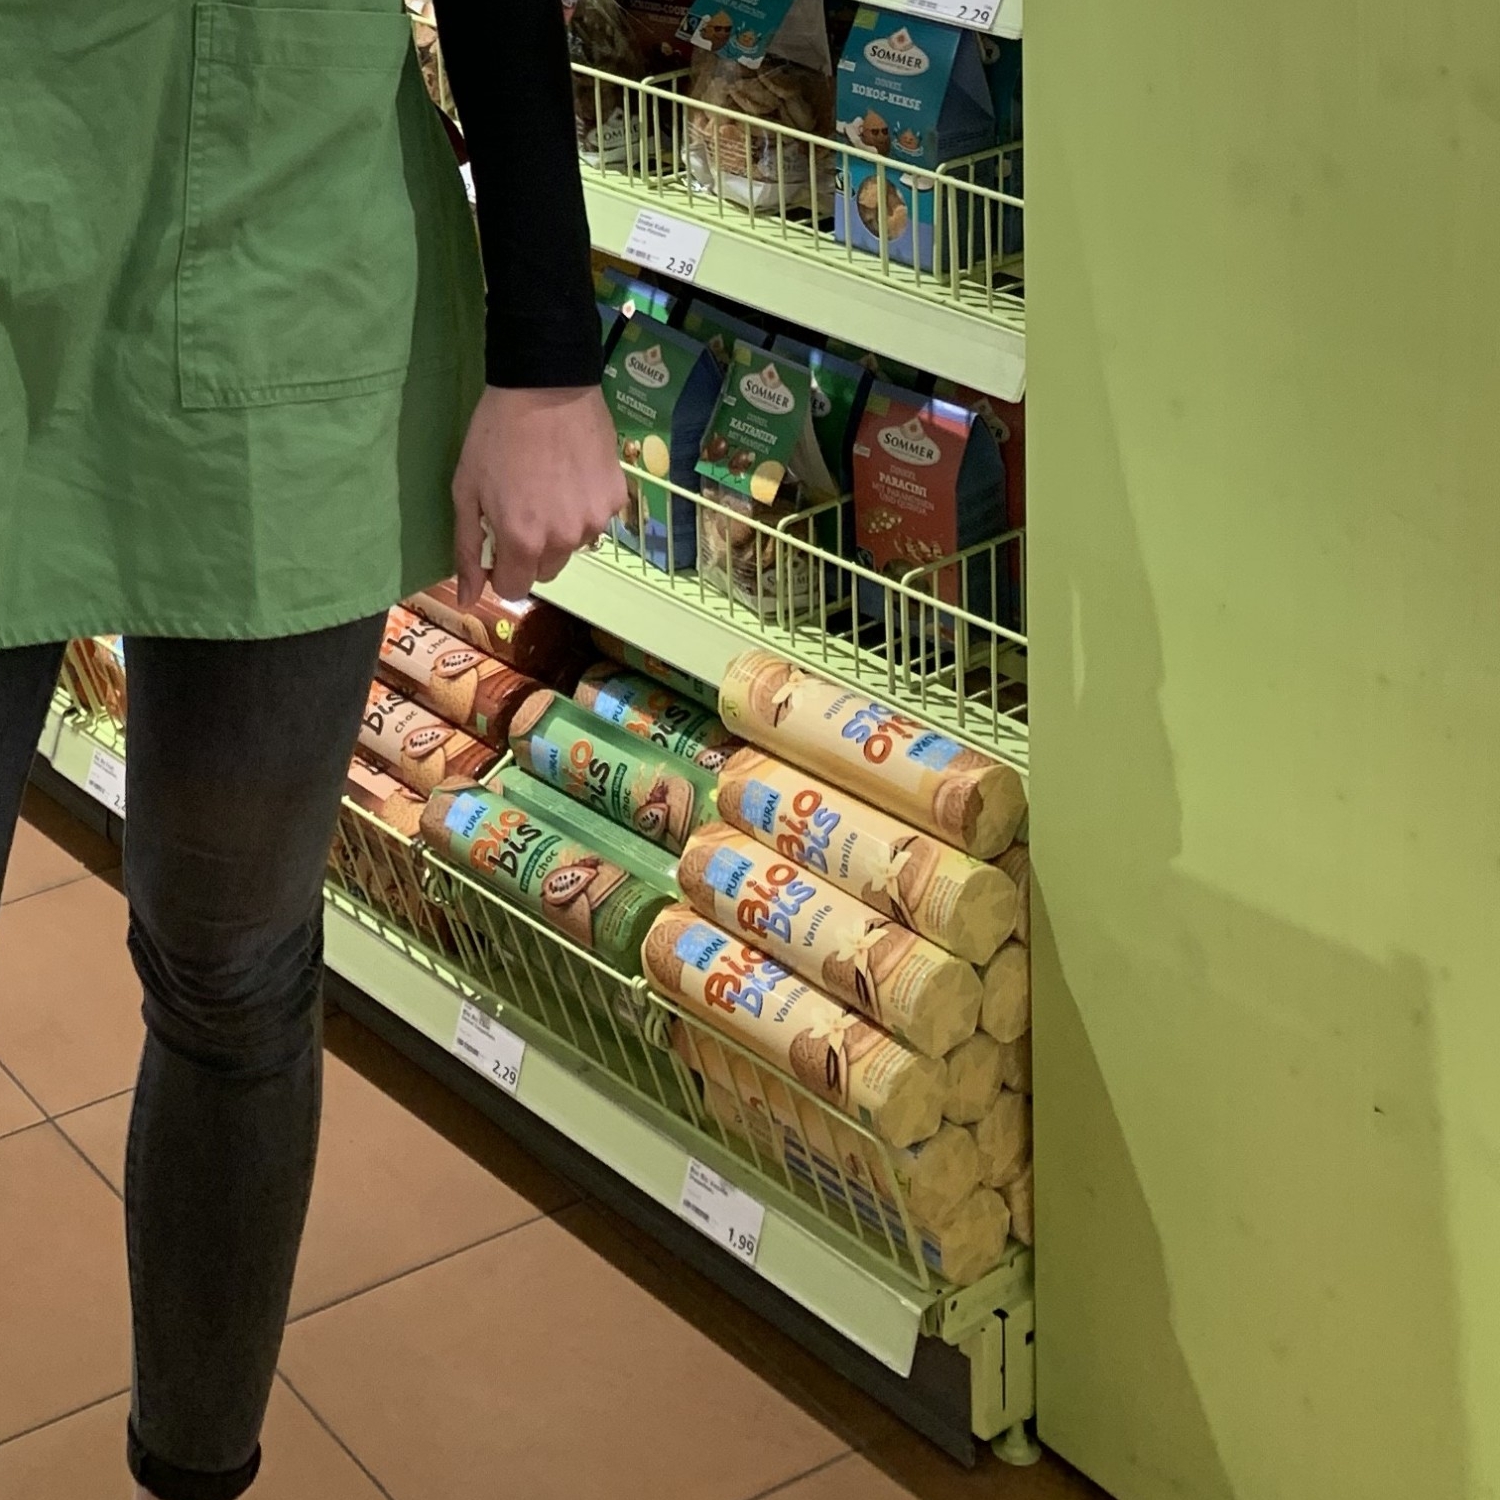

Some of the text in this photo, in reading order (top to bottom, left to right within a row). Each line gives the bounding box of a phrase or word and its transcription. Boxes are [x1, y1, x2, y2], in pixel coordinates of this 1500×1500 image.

[956, 5, 991, 24] 2,29
[869, 45, 923, 70] SOMMER
[851, 82, 923, 111] KOKOS-KEKSE
[666, 256, 695, 277] 2,39
[627, 356, 666, 384] SOMMER
[744, 380, 791, 409] SOMMER
[729, 417, 779, 446] KASTANIEN
[883, 432, 935, 461] SOMMER
[878, 471, 929, 498] PARACINI
[387, 618, 436, 656] bis
[427, 636, 451, 655] Choc
[362, 692, 410, 736] bis
[395, 709, 419, 734] Choc
[612, 689, 636, 723] PURAL
[685, 729, 708, 759] Choc
[462, 805, 489, 839] PURAL
[762, 791, 780, 833] PURAL
[488, 824, 542, 878] bis
[802, 807, 841, 875] bis
[839, 831, 859, 880] Vanille
[535, 848, 559, 880] Choc
[724, 859, 753, 899] PURAL
[757, 879, 816, 944] bis
[802, 903, 833, 949] Vanille
[695, 936, 729, 971] PURAL
[726, 959, 794, 1019] bis
[773, 984, 810, 1024] Vanille
[492, 1059, 517, 1086] 2,29
[728, 1226, 755, 1256] 1,99
